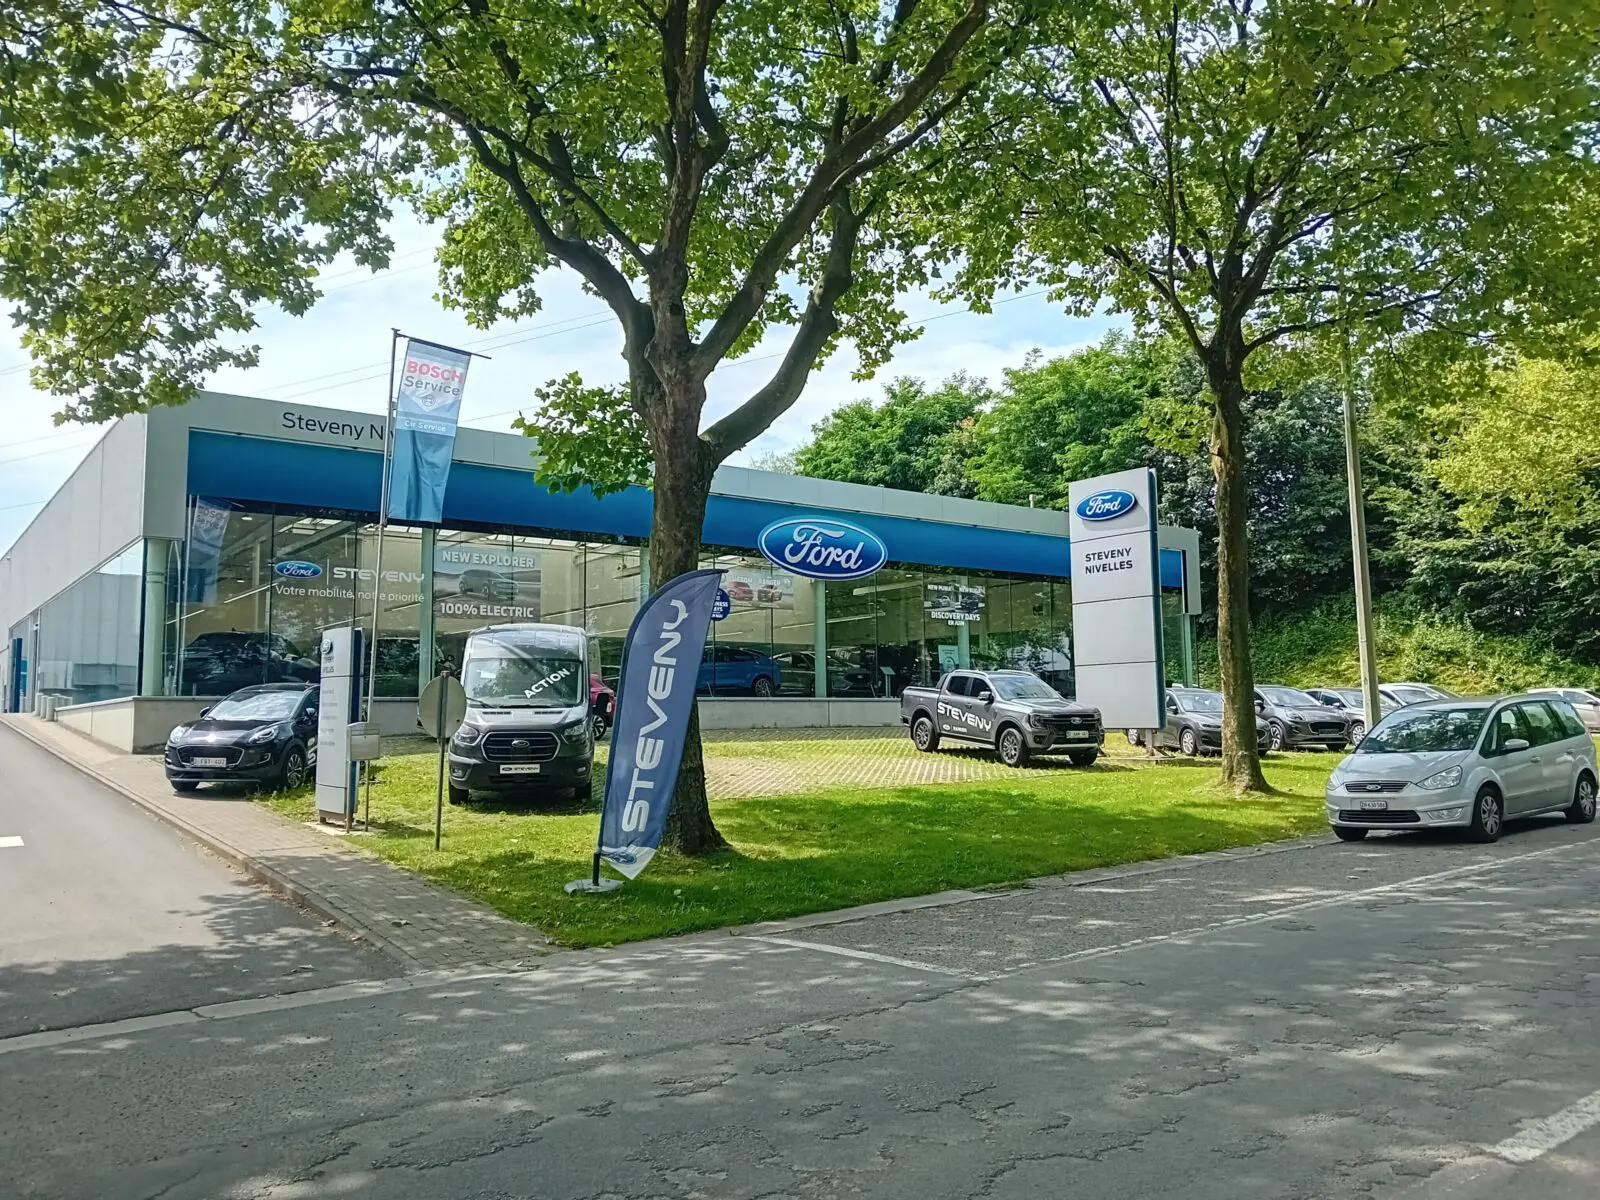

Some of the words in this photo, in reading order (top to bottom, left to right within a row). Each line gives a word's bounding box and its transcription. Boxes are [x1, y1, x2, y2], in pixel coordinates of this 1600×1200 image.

[406, 360, 464, 384] BOSCH
[403, 375, 461, 396] Service
[282, 411, 365, 441] Steveny
[1086, 494, 1122, 515] Ford
[784, 524, 865, 570] Ford
[1085, 547, 1132, 562] STEVENY
[442, 551, 470, 563] NEW
[472, 553, 534, 568] EXPLORER
[1085, 560, 1133, 575] NIVELLES
[283, 563, 314, 577] Ford
[333, 567, 425, 583] STEVENY
[275, 585, 306, 596] Votre
[357, 590, 386, 601] note
[388, 592, 425, 604] priorité
[440, 602, 478, 615] 100%
[479, 604, 534, 617] ELECTRIC
[931, 611, 964, 620] DISCOVERY
[964, 613, 981, 621] DAYS
[524, 667, 571, 699] ACTION
[621, 598, 690, 833] STEVENY
[937, 702, 992, 732] STEVENY
